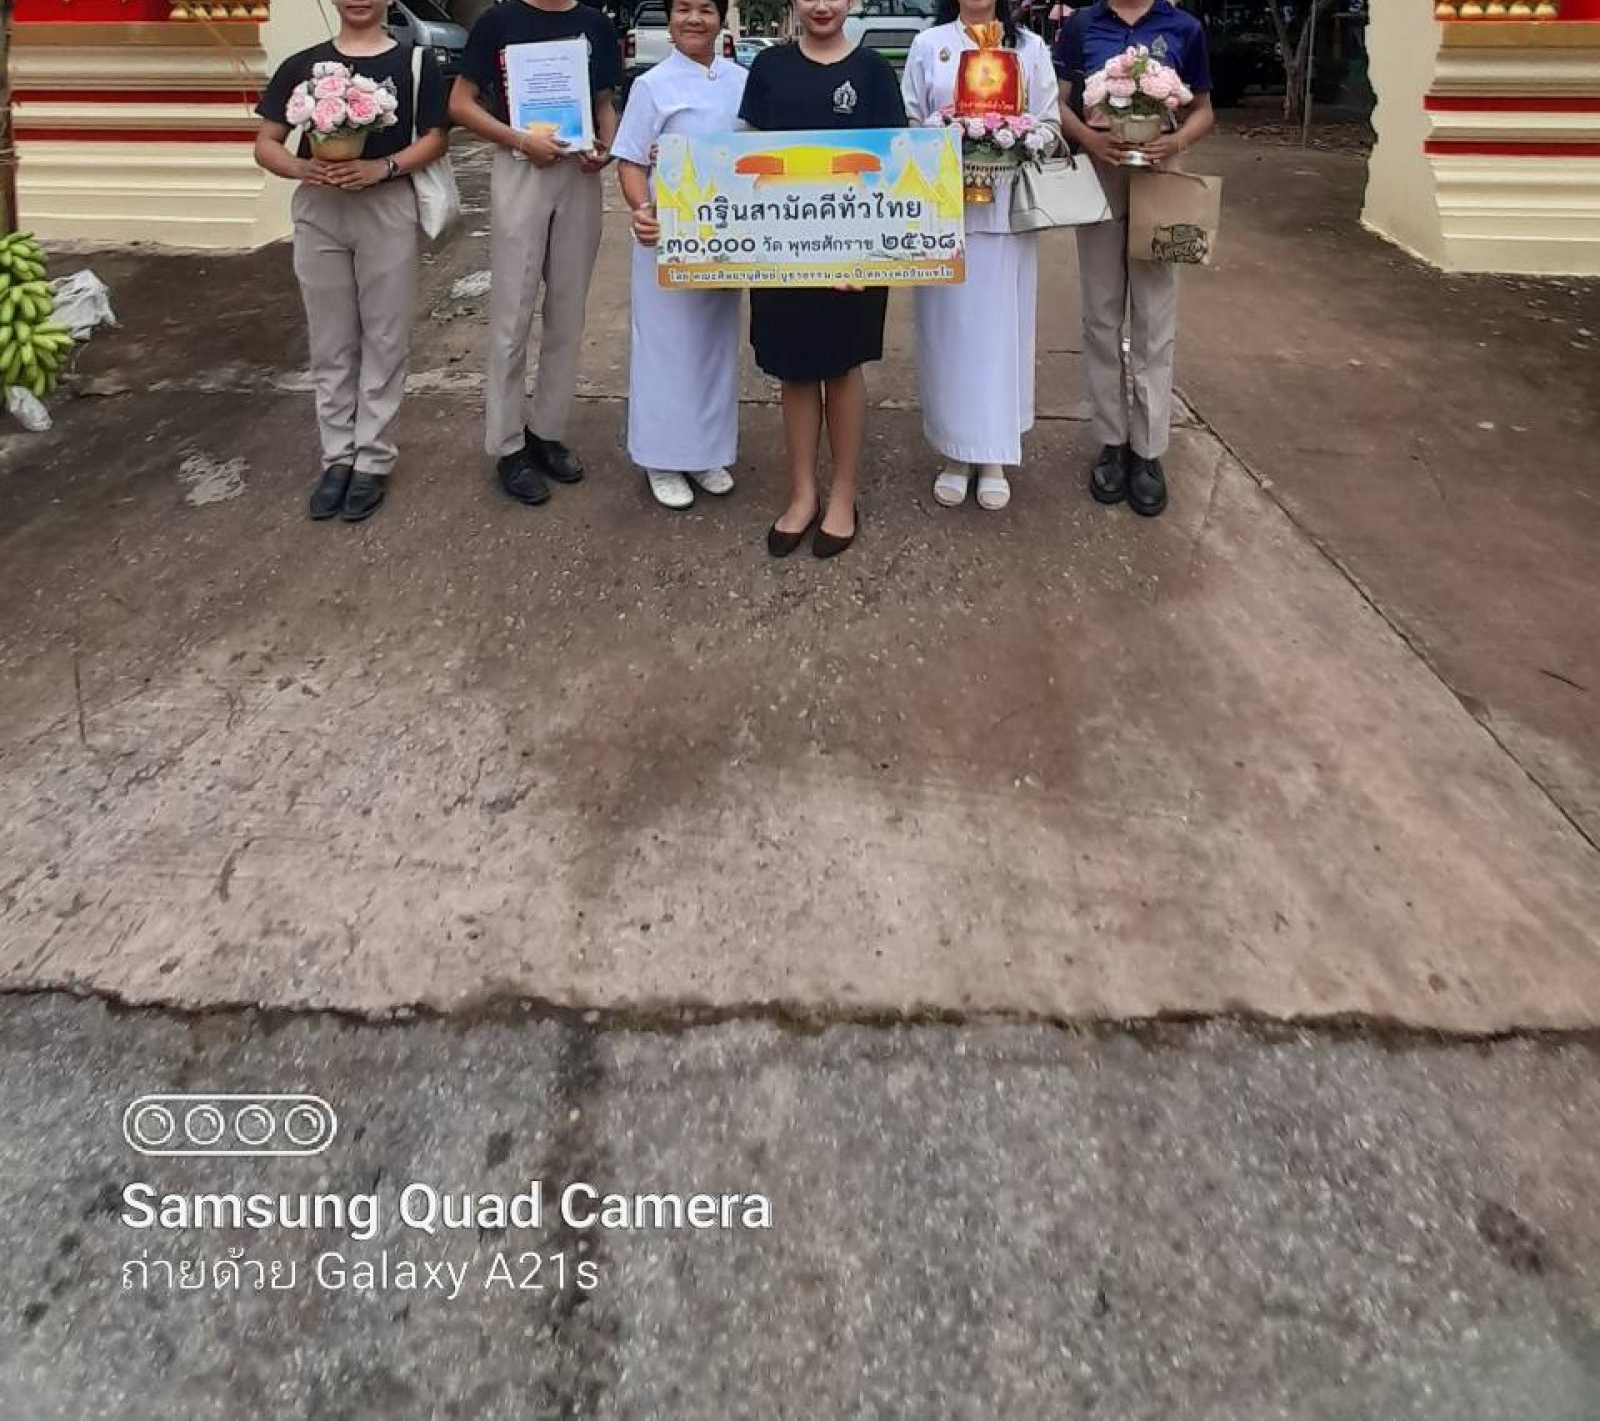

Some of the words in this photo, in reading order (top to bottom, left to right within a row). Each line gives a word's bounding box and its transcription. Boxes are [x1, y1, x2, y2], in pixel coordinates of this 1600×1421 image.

[697, 186, 921, 228] กฐินสามัคคีทั่วไทย
[666, 236, 756, 255] ๓๐,๐๐๐
[763, 234, 783, 252] วัด
[788, 236, 874, 258] พุทธศักราช
[881, 231, 956, 250] ๒๕๖๘
